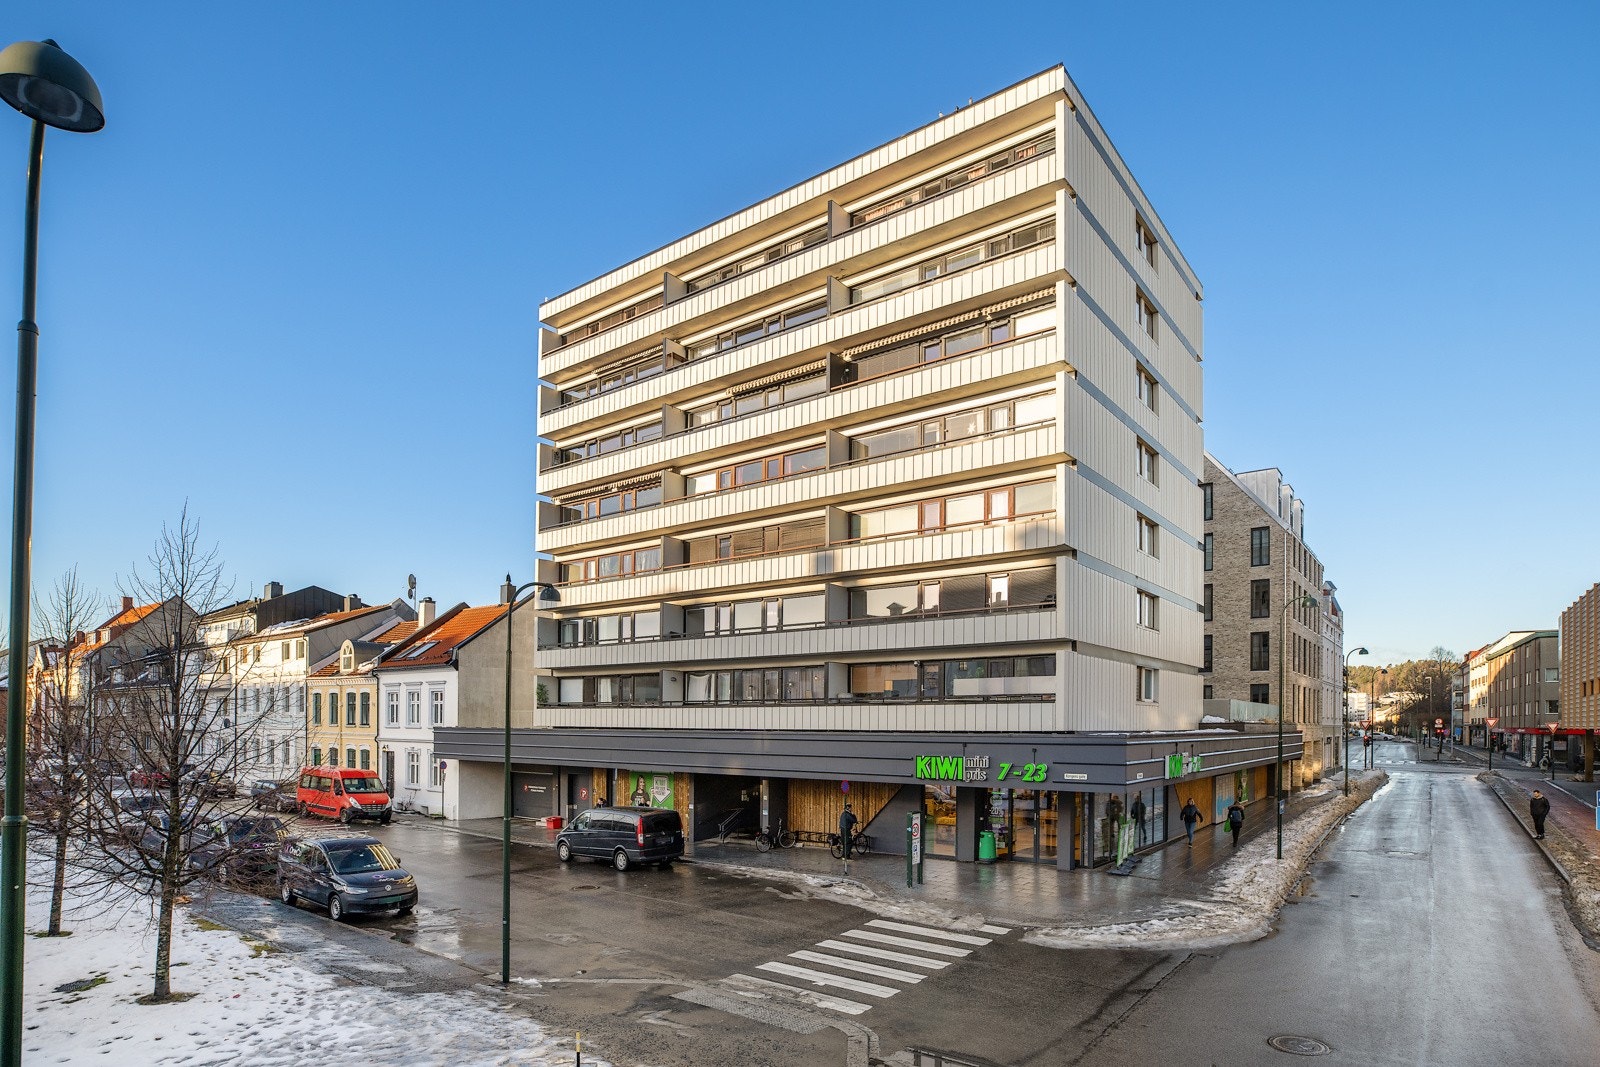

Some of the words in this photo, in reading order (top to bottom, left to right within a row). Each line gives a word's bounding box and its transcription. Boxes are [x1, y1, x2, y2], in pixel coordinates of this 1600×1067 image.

[916, 756, 963, 780] KIWI
[965, 756, 989, 768] mini
[965, 769, 987, 783] pris
